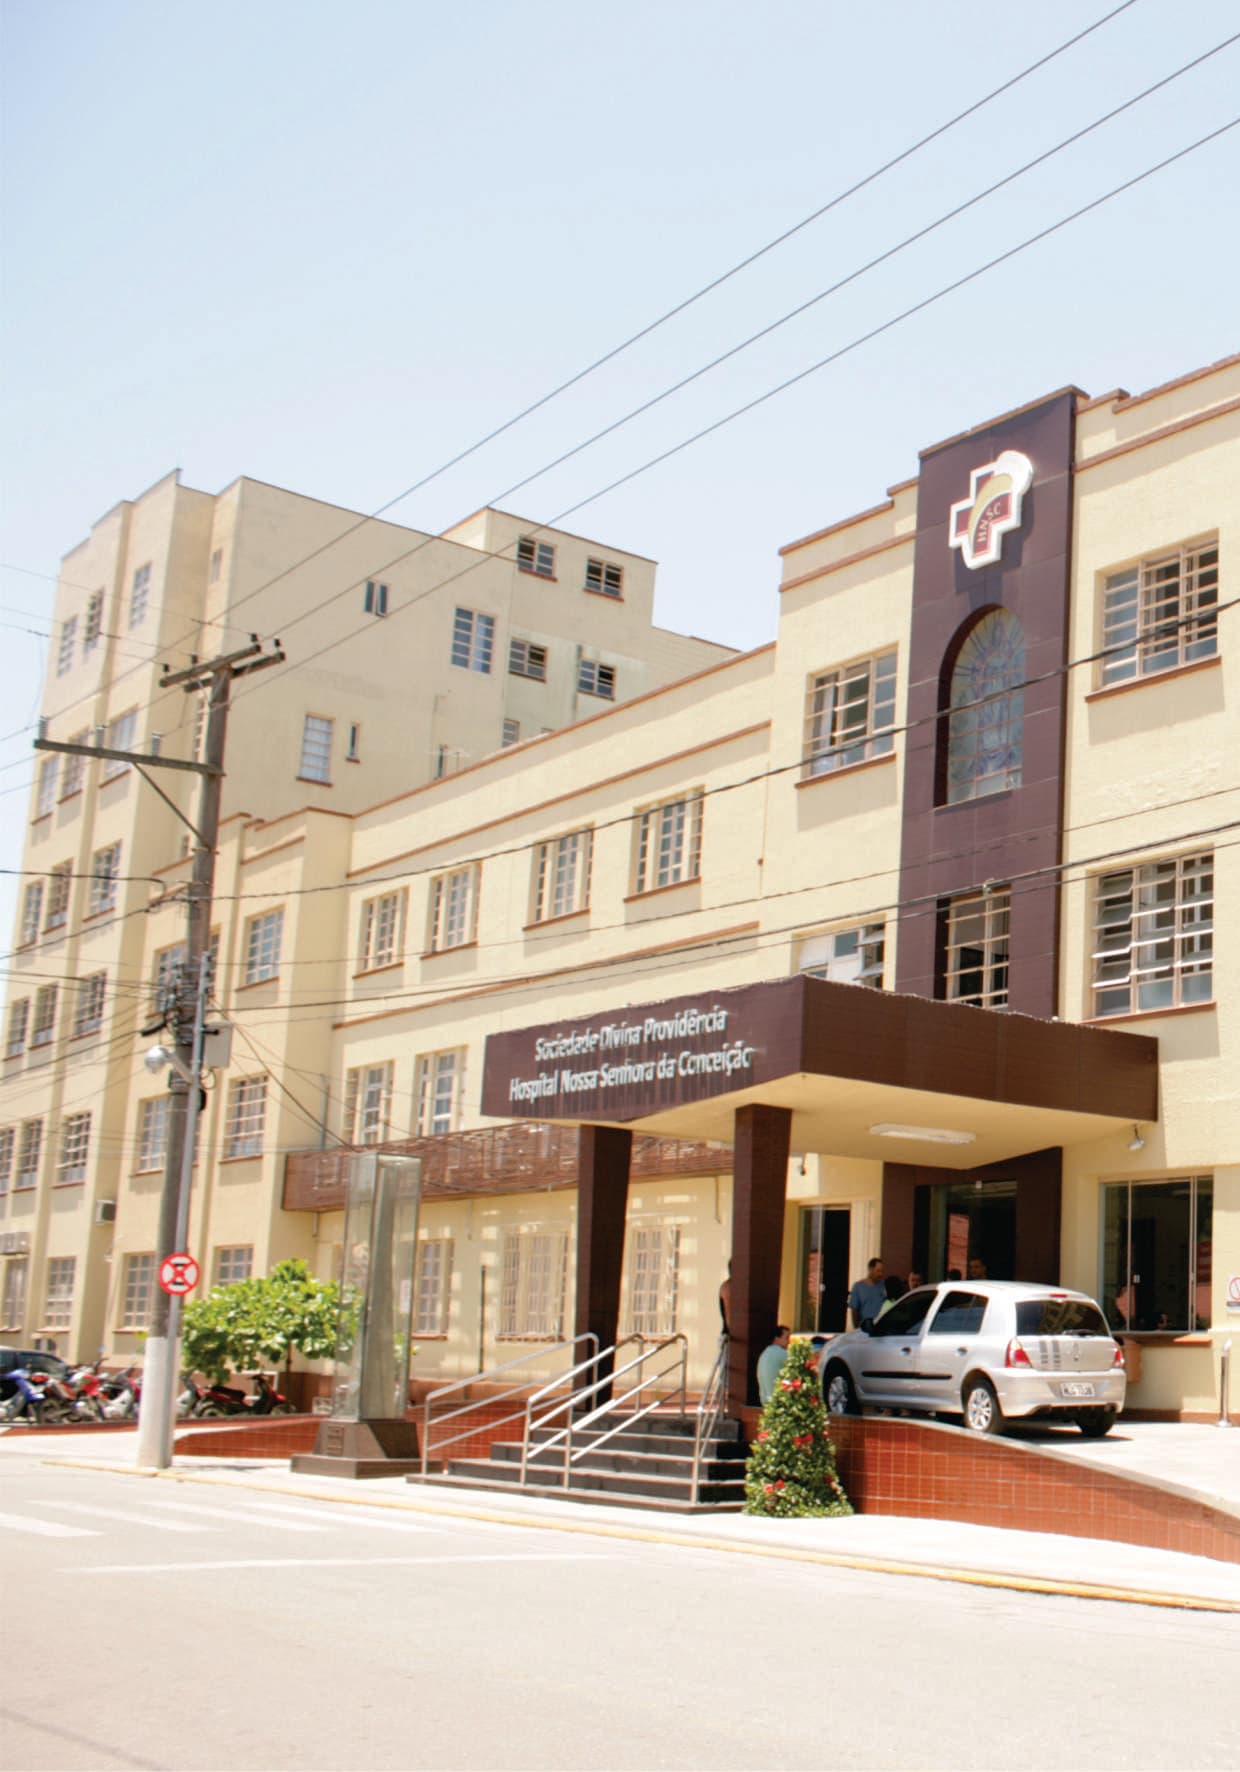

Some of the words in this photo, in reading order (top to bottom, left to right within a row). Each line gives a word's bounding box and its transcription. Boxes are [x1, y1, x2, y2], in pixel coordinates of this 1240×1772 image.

[535, 1028, 598, 1061] Sociedade
[599, 1021, 641, 1049] Divina
[643, 1005, 728, 1042] Providência
[509, 1070, 559, 1104] Hospital
[560, 1069, 598, 1093] Nossa
[599, 1060, 654, 1088] Senhora
[657, 1053, 676, 1080] da
[678, 1041, 753, 1076] Conceição
